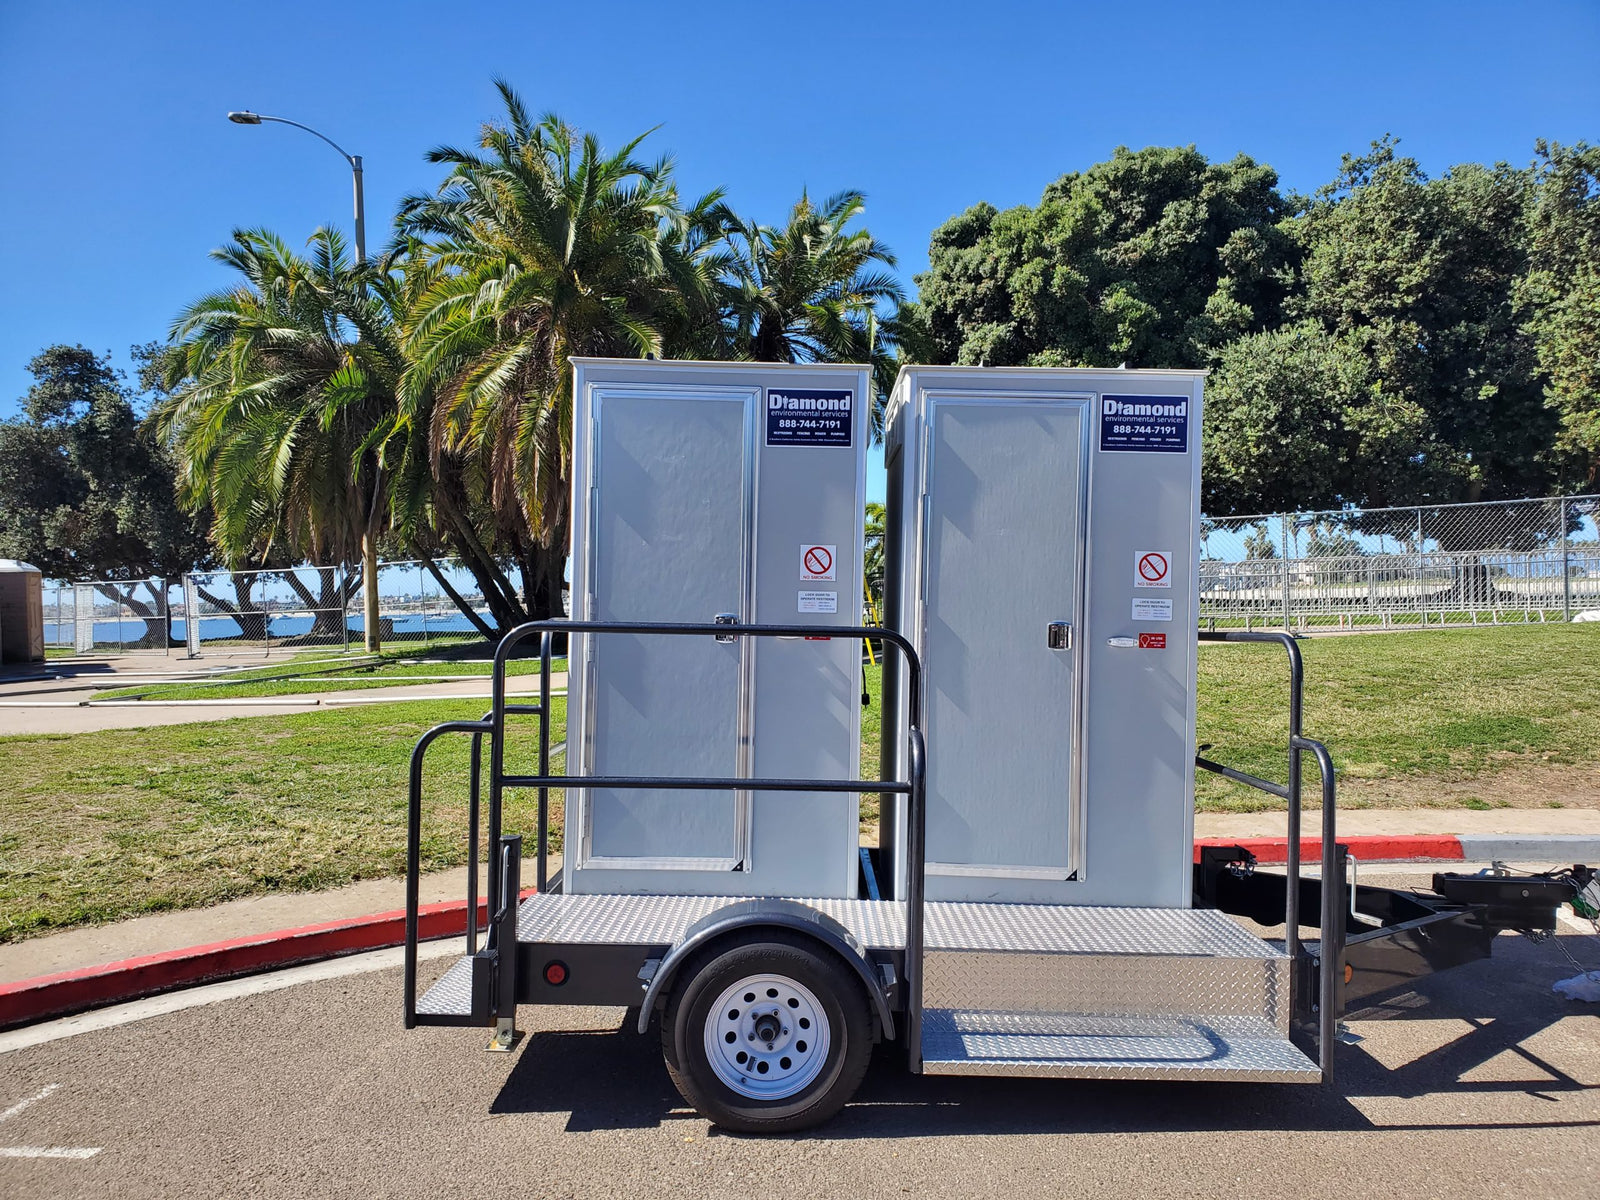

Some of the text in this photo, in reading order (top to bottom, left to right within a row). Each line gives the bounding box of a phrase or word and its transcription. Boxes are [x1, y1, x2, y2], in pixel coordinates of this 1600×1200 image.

[769, 394, 851, 411] Diamond
[1103, 400, 1187, 417] Diamond
[779, 419, 841, 429] 888-744-7191
[1105, 415, 1185, 424] environmental services
[1113, 425, 1177, 435] 888-744-7191
